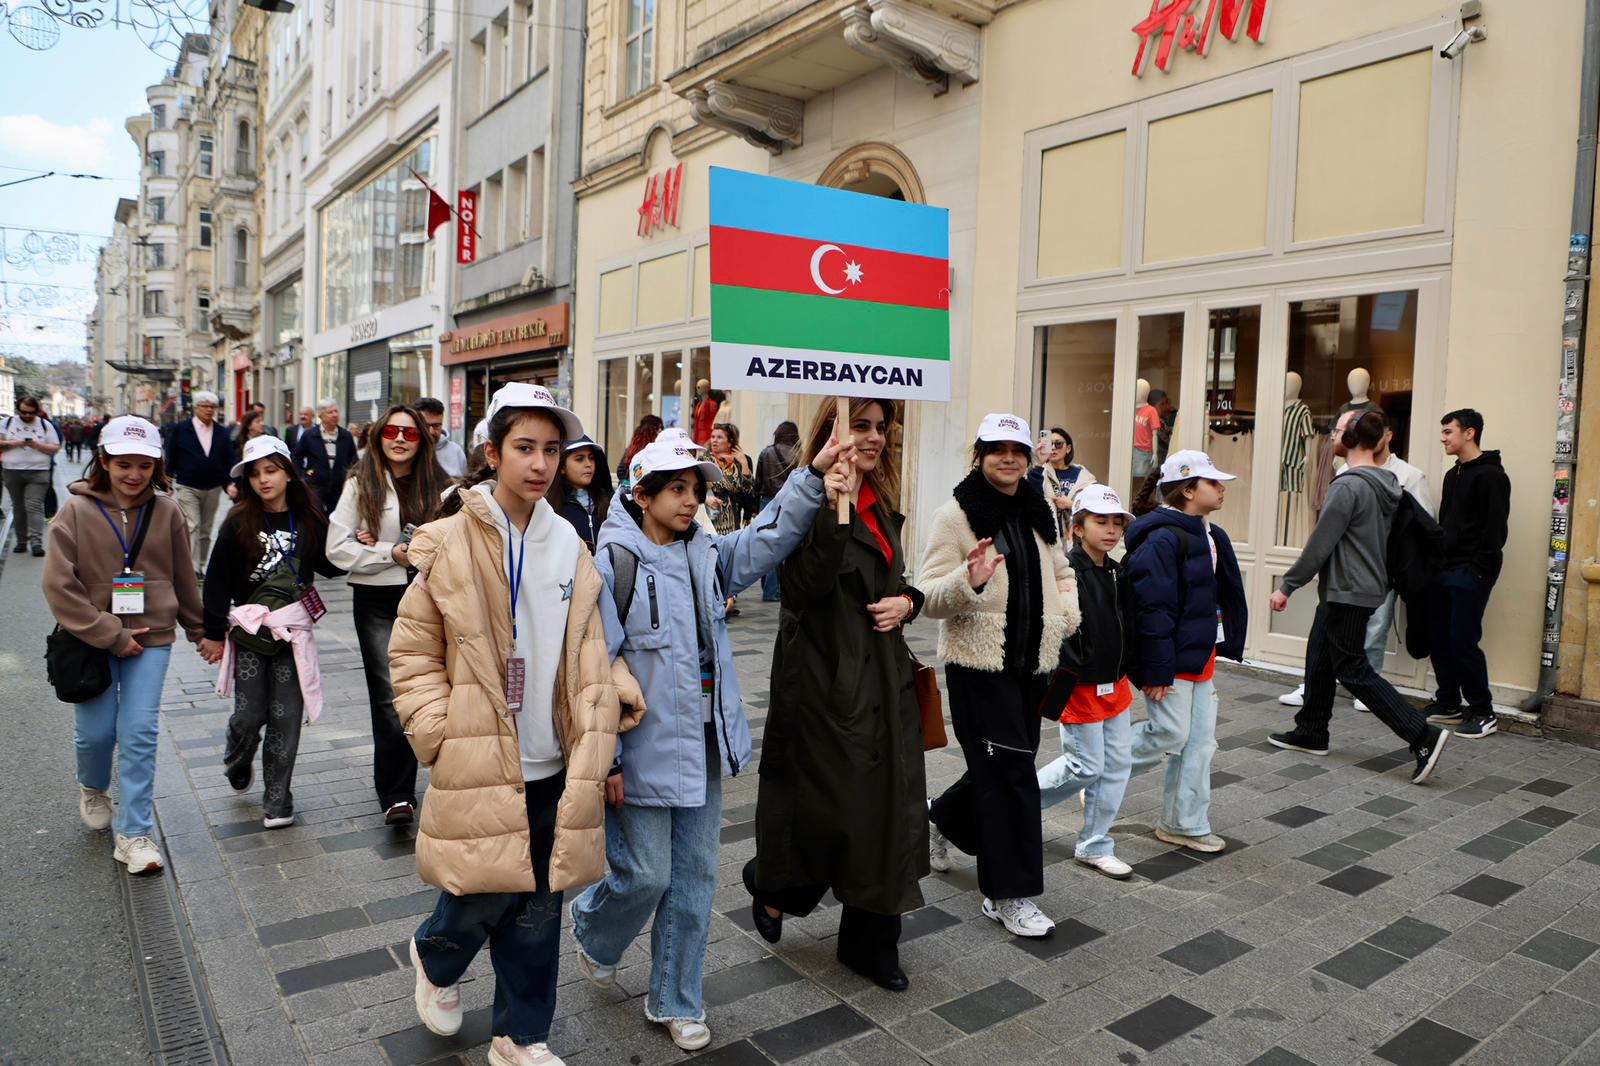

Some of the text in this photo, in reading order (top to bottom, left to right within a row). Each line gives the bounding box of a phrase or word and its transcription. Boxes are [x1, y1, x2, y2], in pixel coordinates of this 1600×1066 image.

[637, 162, 684, 236] H&M
[746, 356, 923, 387] AZERBAYCAN
[1547, 585, 1558, 611] DEUS
